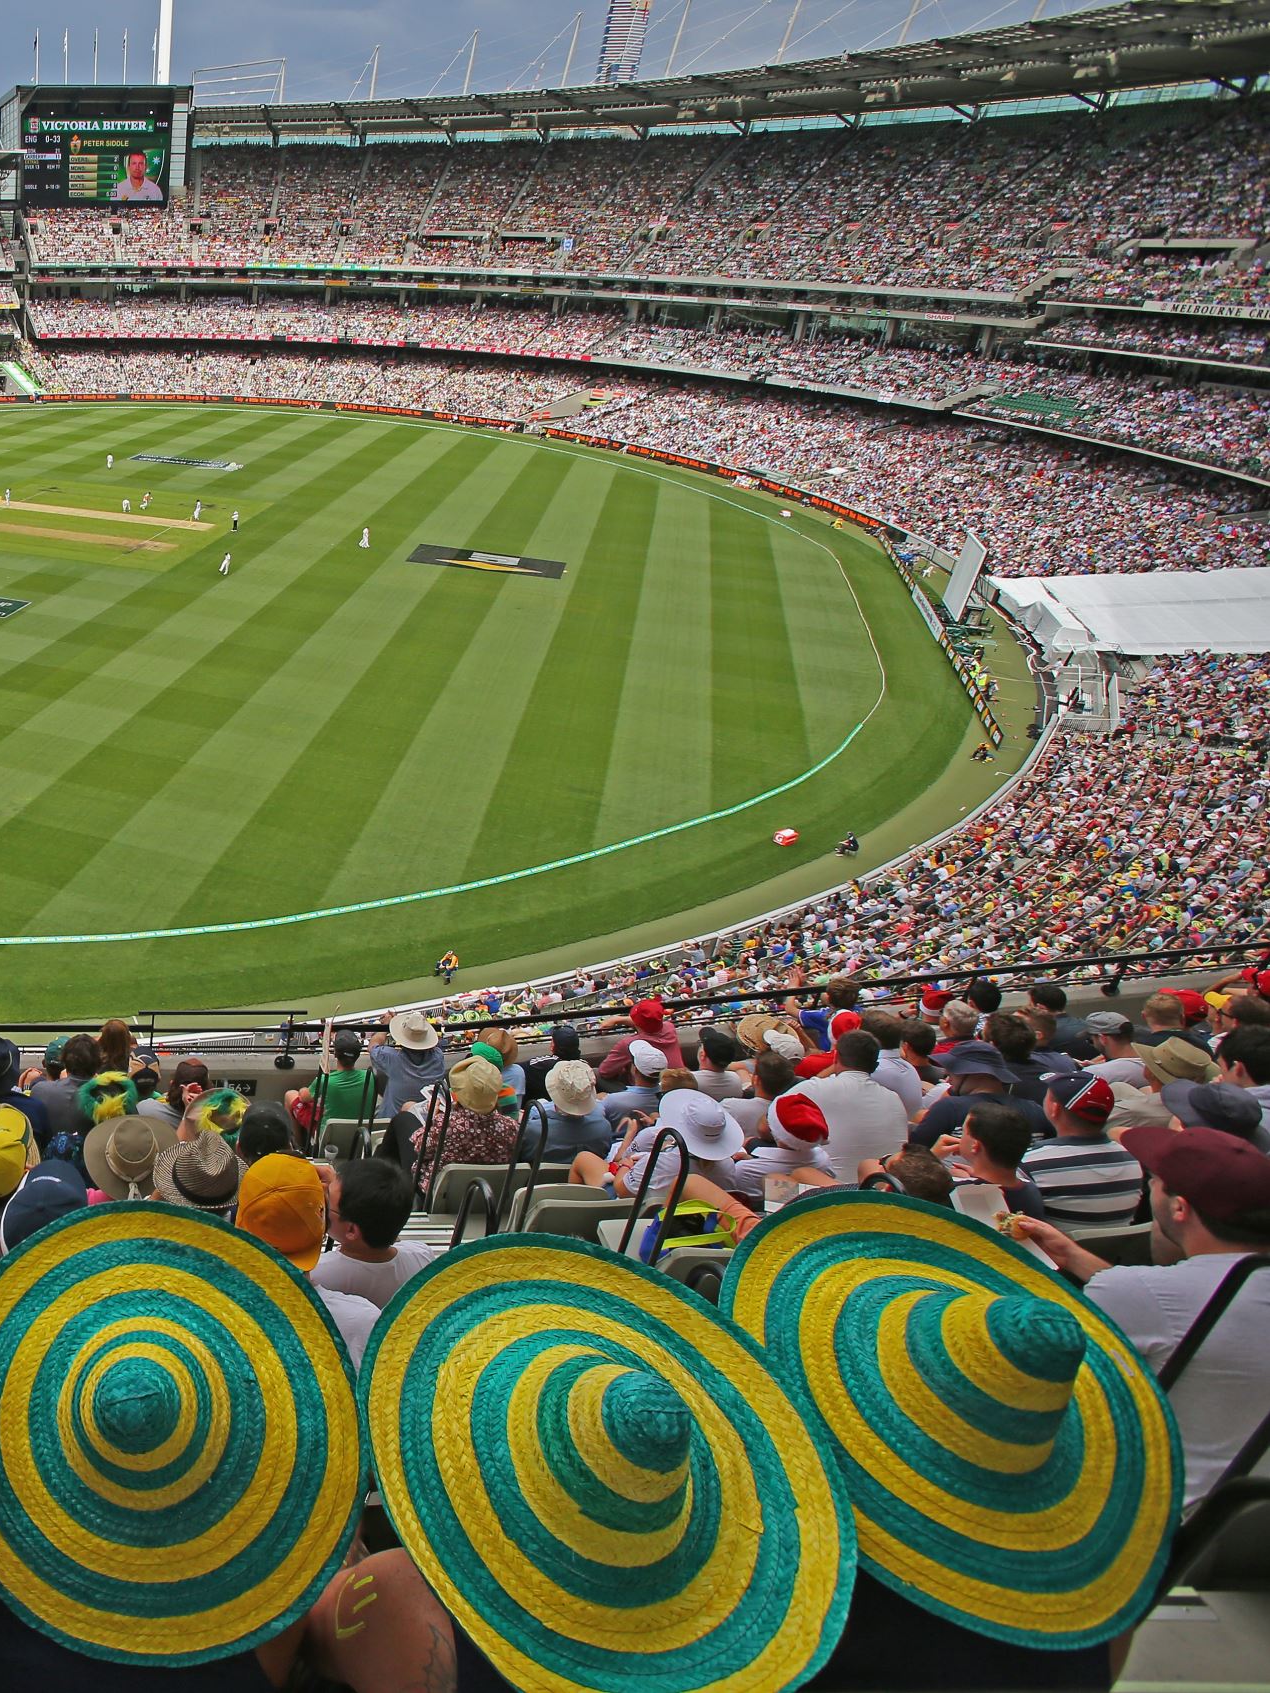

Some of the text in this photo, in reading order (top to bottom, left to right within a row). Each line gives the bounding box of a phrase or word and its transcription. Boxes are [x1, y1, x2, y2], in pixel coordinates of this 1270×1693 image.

[41, 121, 147, 131] VICTORIA BITTER
[45, 135, 61, 143] 0-33
[1170, 304, 1270, 319] MELBOURNE CRI
[925, 313, 954, 321] SHARP
